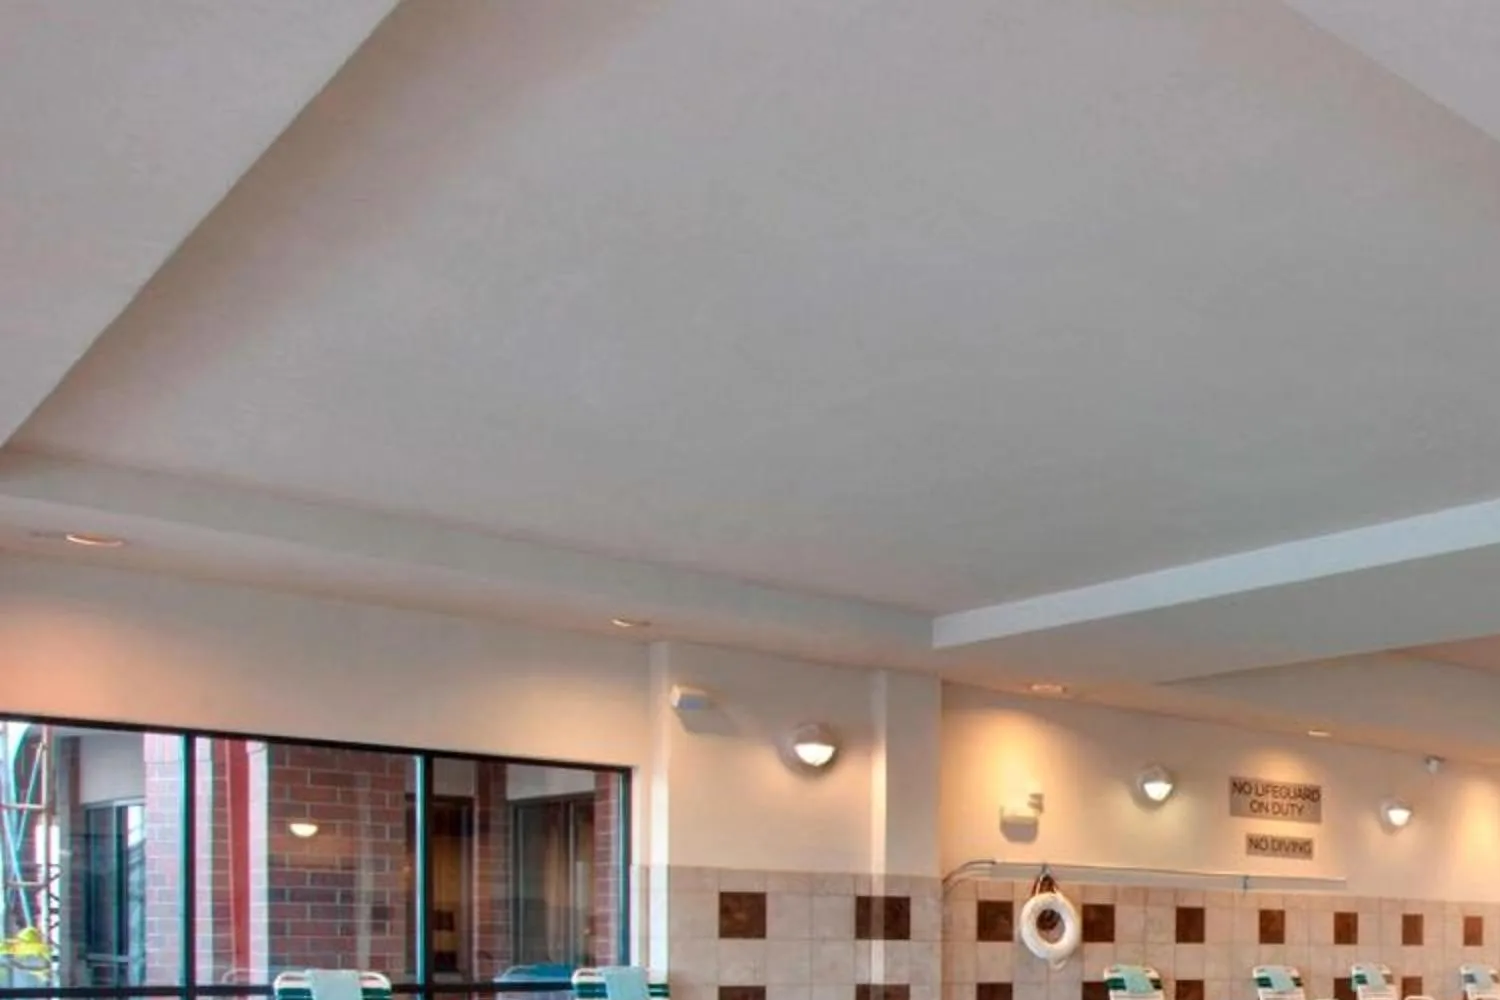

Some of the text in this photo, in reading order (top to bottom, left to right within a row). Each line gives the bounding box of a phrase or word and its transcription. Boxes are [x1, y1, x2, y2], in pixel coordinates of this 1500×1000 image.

[1233, 781, 1320, 802] NO LIFEGUARD
[1250, 800, 1304, 816] ON DUTY
[1249, 838, 1311, 855] NO DIVING
